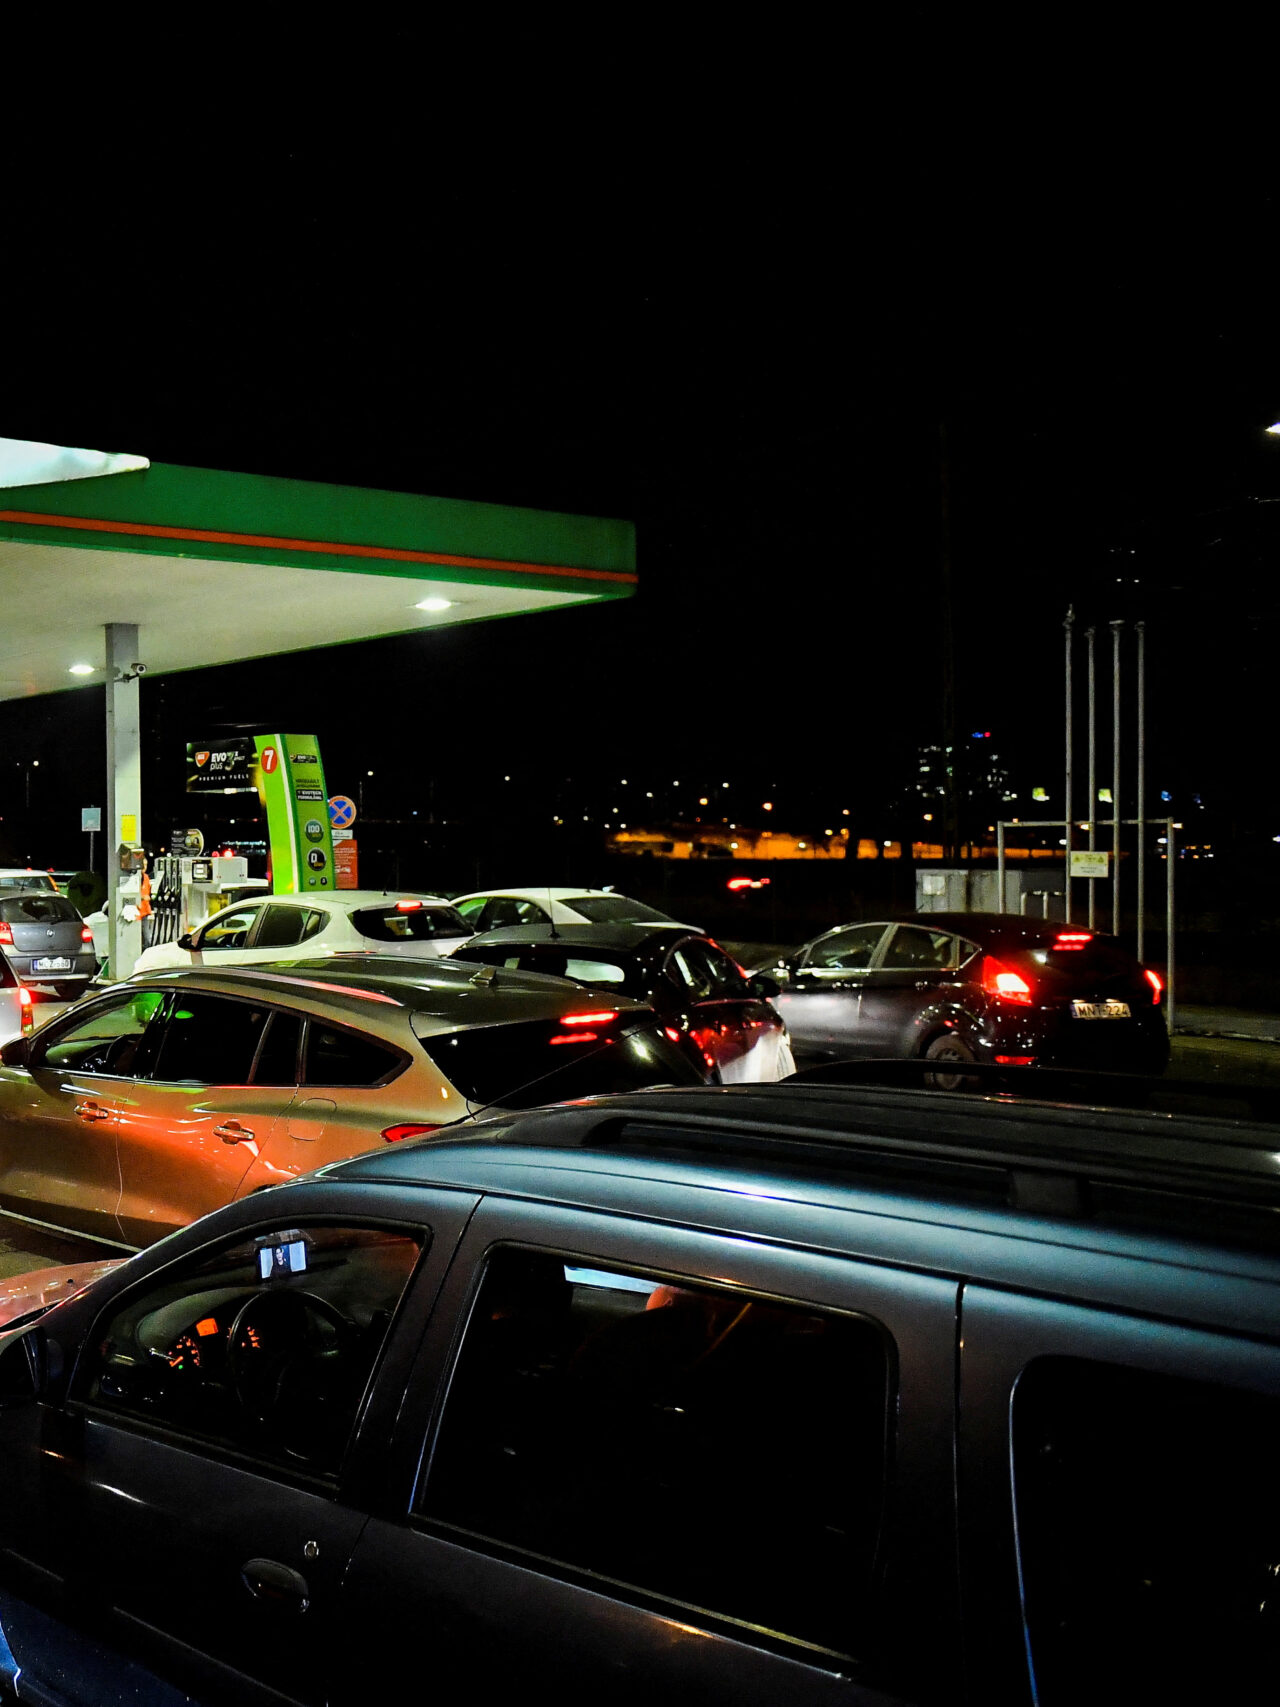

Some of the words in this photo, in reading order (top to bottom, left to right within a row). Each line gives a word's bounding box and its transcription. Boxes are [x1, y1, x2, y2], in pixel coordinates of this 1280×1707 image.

[211, 752, 226, 763] EVO
[264, 750, 274, 770] 7
[311, 853, 317, 864] D
